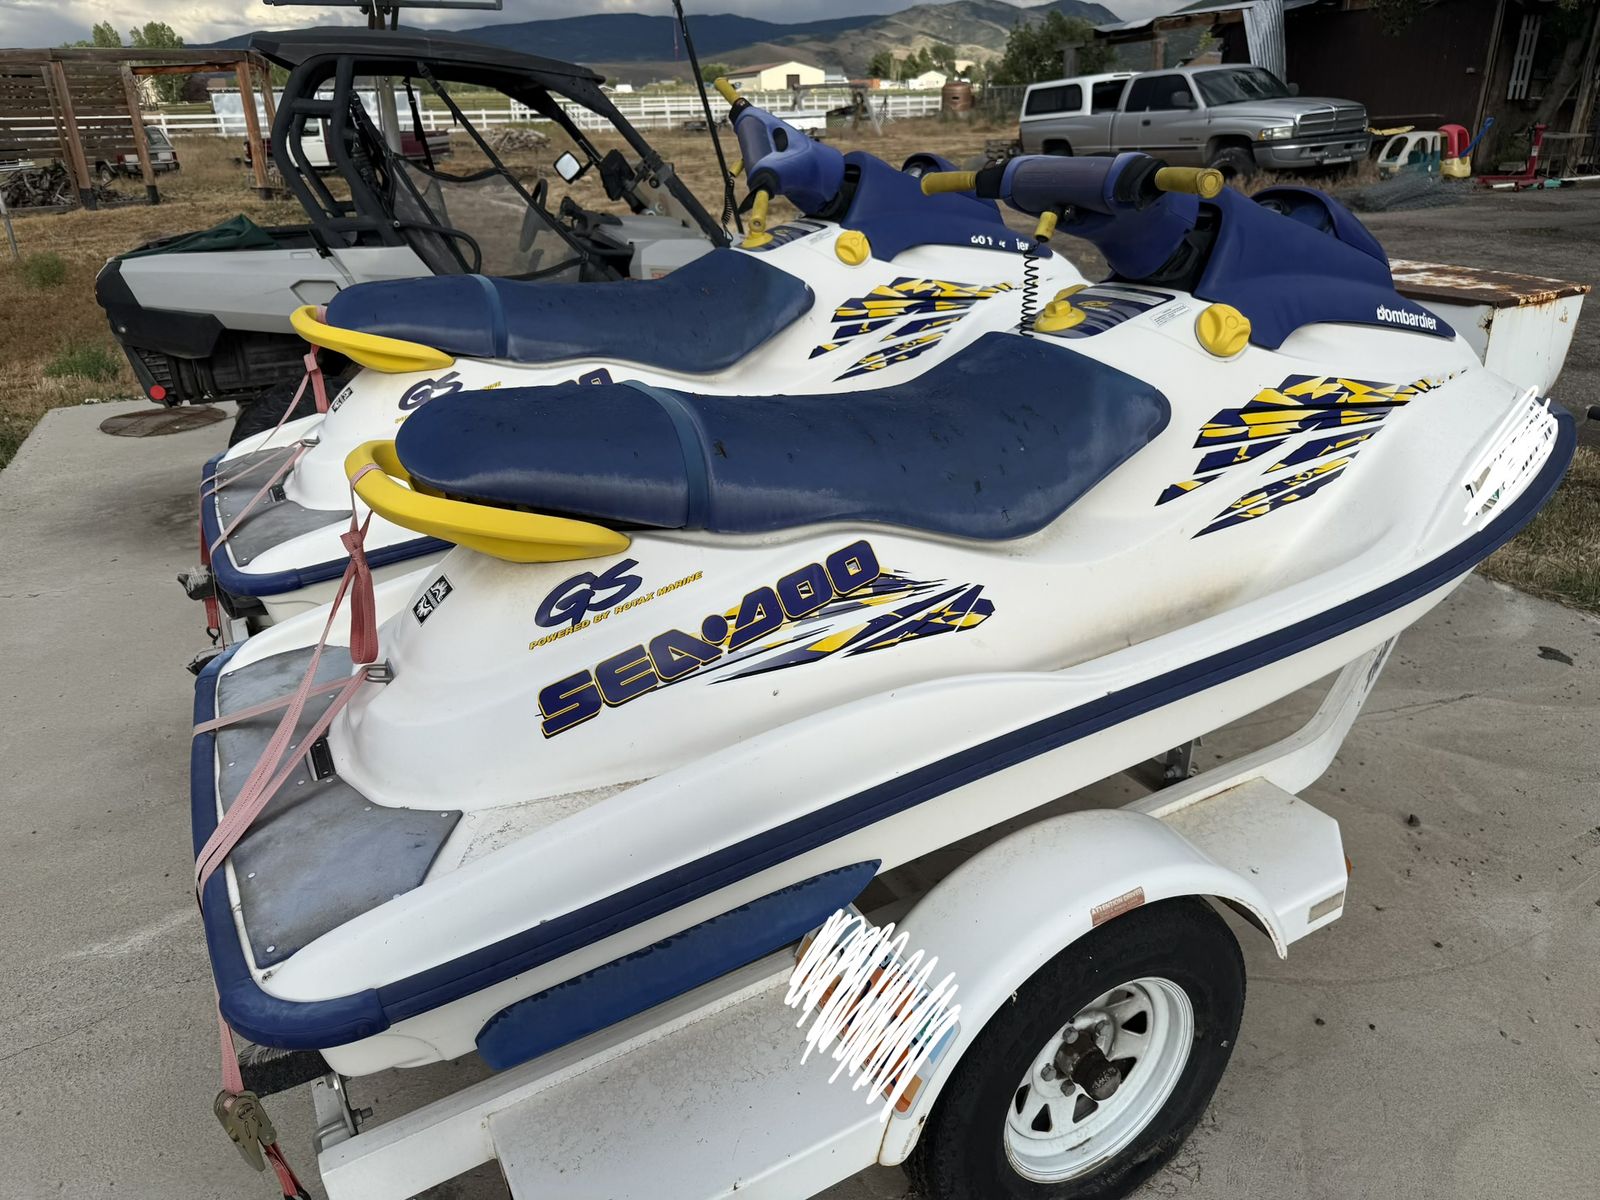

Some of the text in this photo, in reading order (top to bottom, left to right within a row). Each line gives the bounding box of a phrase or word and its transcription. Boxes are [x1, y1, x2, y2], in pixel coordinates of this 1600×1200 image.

[1376, 304, 1437, 330] Bombardier
[529, 570, 704, 650] POWERED BY ROTAX MARINE
[534, 558, 643, 628] GS
[1092, 896, 1123, 914] ATTENTION
[1123, 887, 1144, 902] DRIVER
